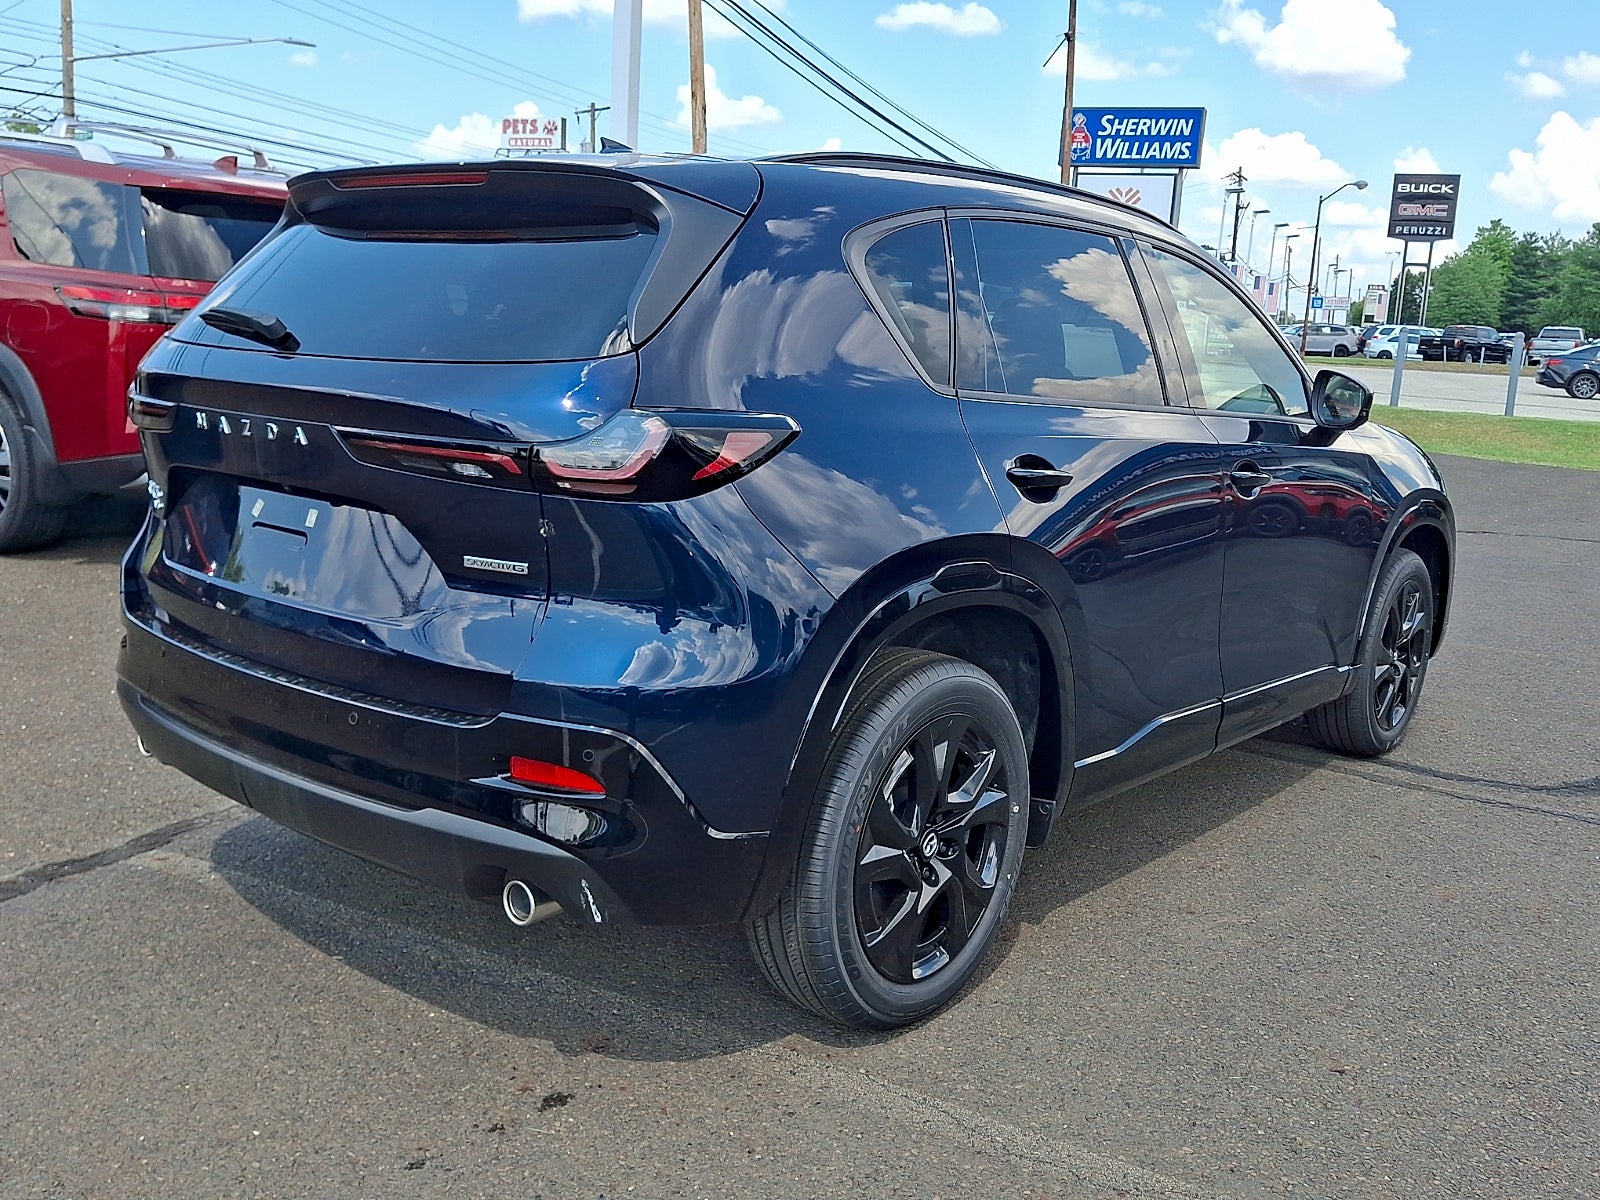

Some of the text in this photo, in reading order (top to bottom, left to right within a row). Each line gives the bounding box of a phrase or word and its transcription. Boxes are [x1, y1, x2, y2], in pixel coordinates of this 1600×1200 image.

[502, 118, 539, 134] PETS
[1097, 114, 1194, 136] SHERWIN
[509, 138, 551, 146] NATURAL
[1095, 138, 1193, 160] WILLIAMS
[1397, 183, 1455, 194] BUICK
[1398, 203, 1449, 217] GMC
[1395, 226, 1447, 235] PERUZZI
[195, 411, 309, 446] MAZDA
